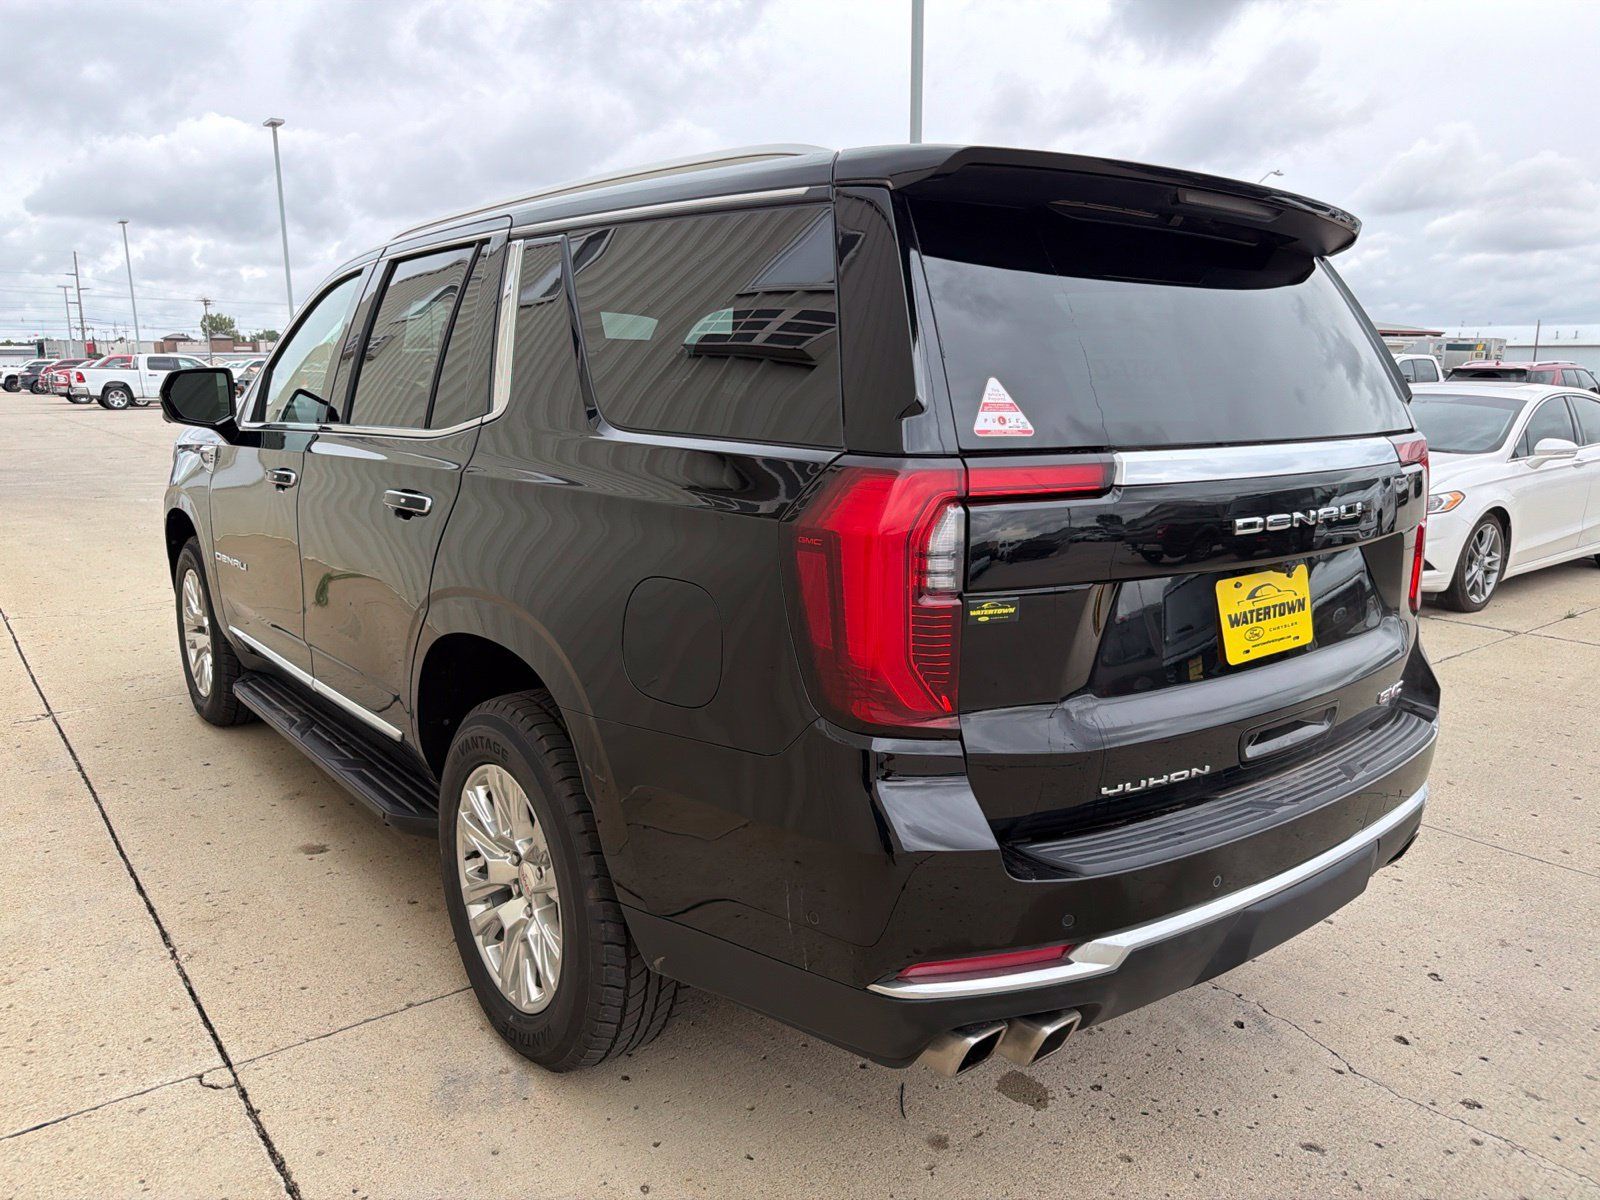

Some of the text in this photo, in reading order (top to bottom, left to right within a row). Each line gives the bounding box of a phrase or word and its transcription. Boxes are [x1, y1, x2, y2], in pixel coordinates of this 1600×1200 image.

[1232, 502, 1362, 536] DENALI
[799, 536, 823, 546] GMC
[214, 551, 248, 571] DENALI
[1227, 597, 1306, 628] WATERTOWN
[1269, 621, 1298, 632] CHRYSLER
[458, 735, 509, 762] VANTAGE
[1101, 765, 1210, 796] YUKON
